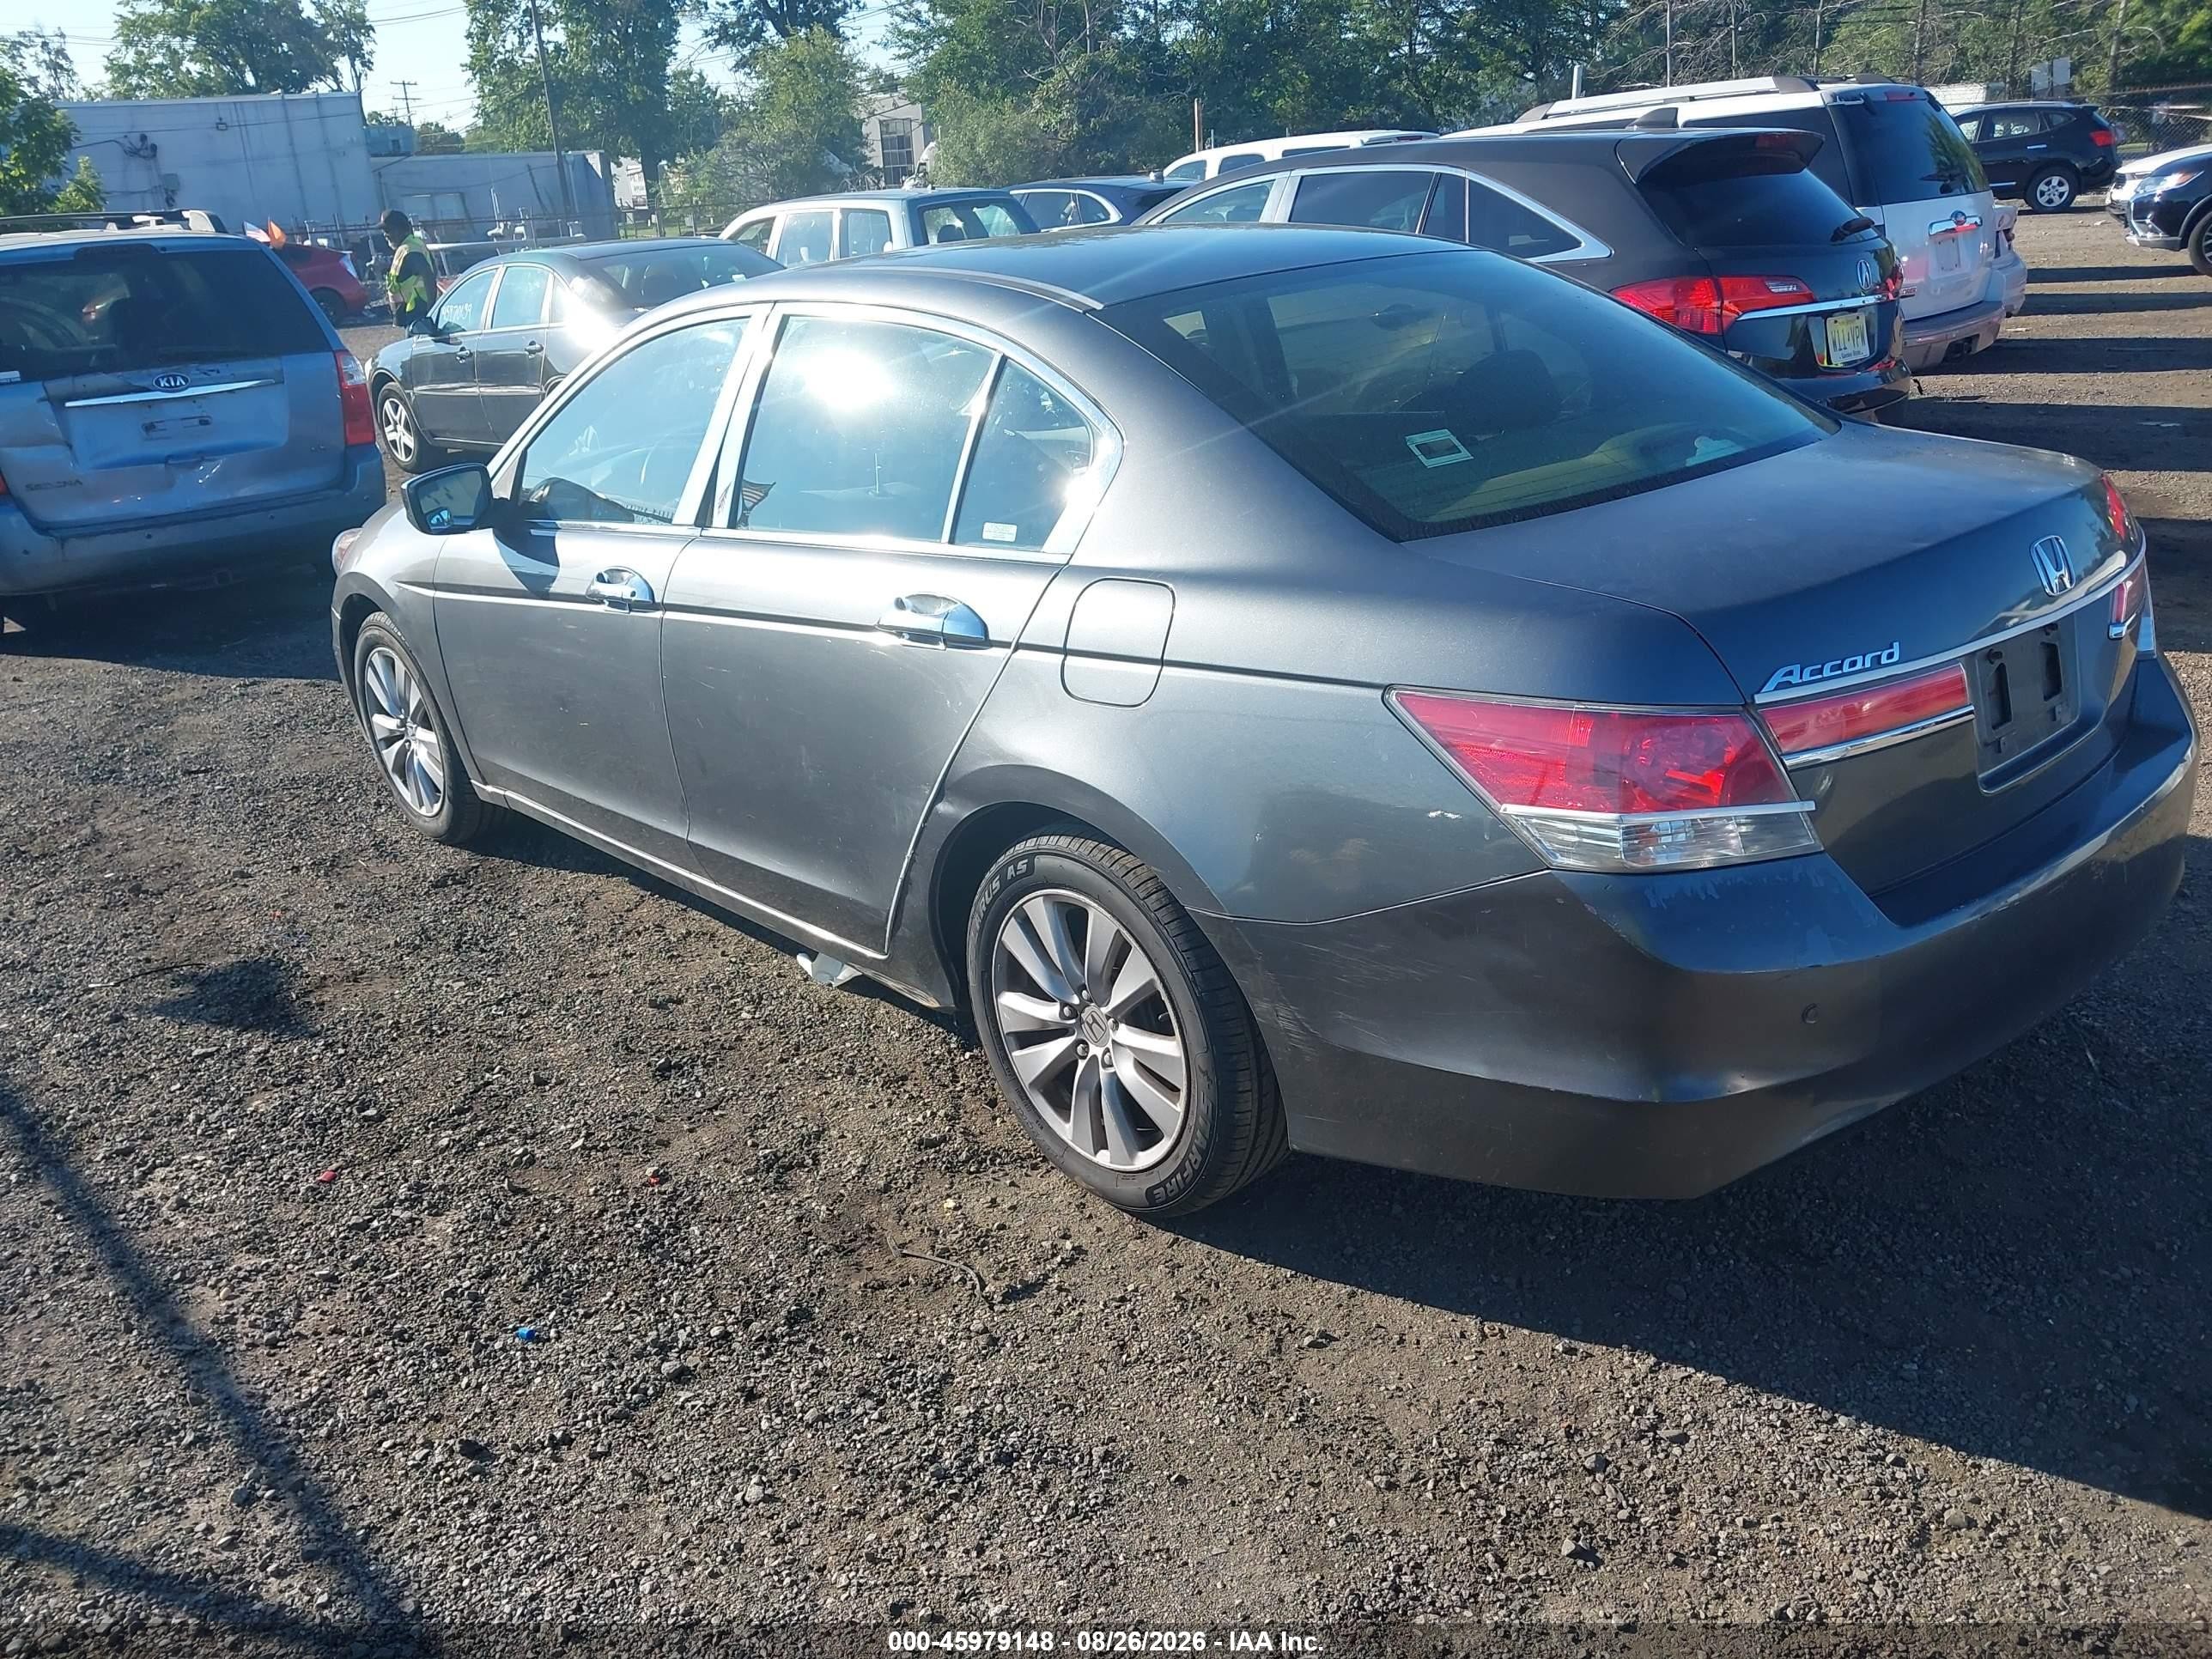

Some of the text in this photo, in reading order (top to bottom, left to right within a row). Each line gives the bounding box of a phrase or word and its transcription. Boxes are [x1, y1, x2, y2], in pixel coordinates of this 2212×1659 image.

[158, 375, 186, 387] KIA
[1760, 641, 1900, 693] Accord
[1006, 859, 1029, 880] AS
